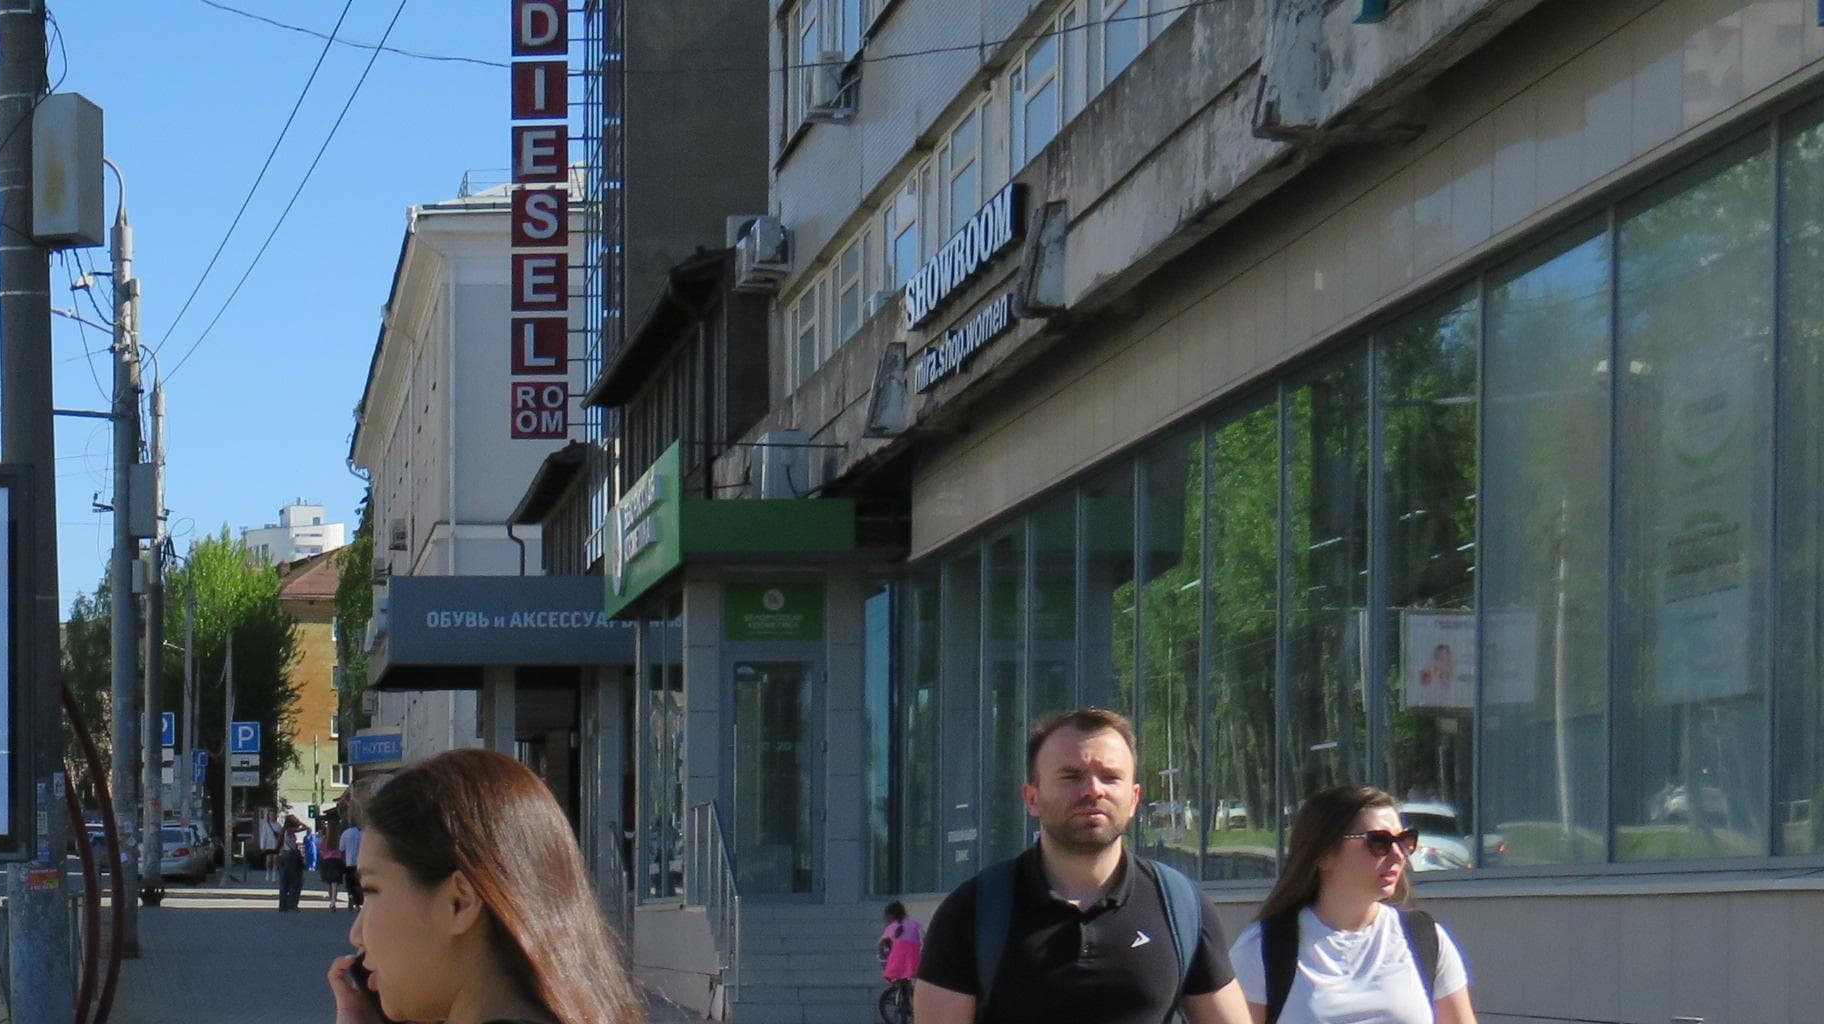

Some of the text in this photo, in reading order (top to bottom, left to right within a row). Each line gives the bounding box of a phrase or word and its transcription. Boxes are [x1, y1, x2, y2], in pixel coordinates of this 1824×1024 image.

[521, 3, 559, 367] DIESEL
[906, 183, 1013, 331] SHOWROOM
[915, 293, 1008, 394] mira.shop.women
[426, 611, 490, 628] ОБУВЬ
[494, 615, 505, 628] и
[362, 741, 400, 754] HOTEL
